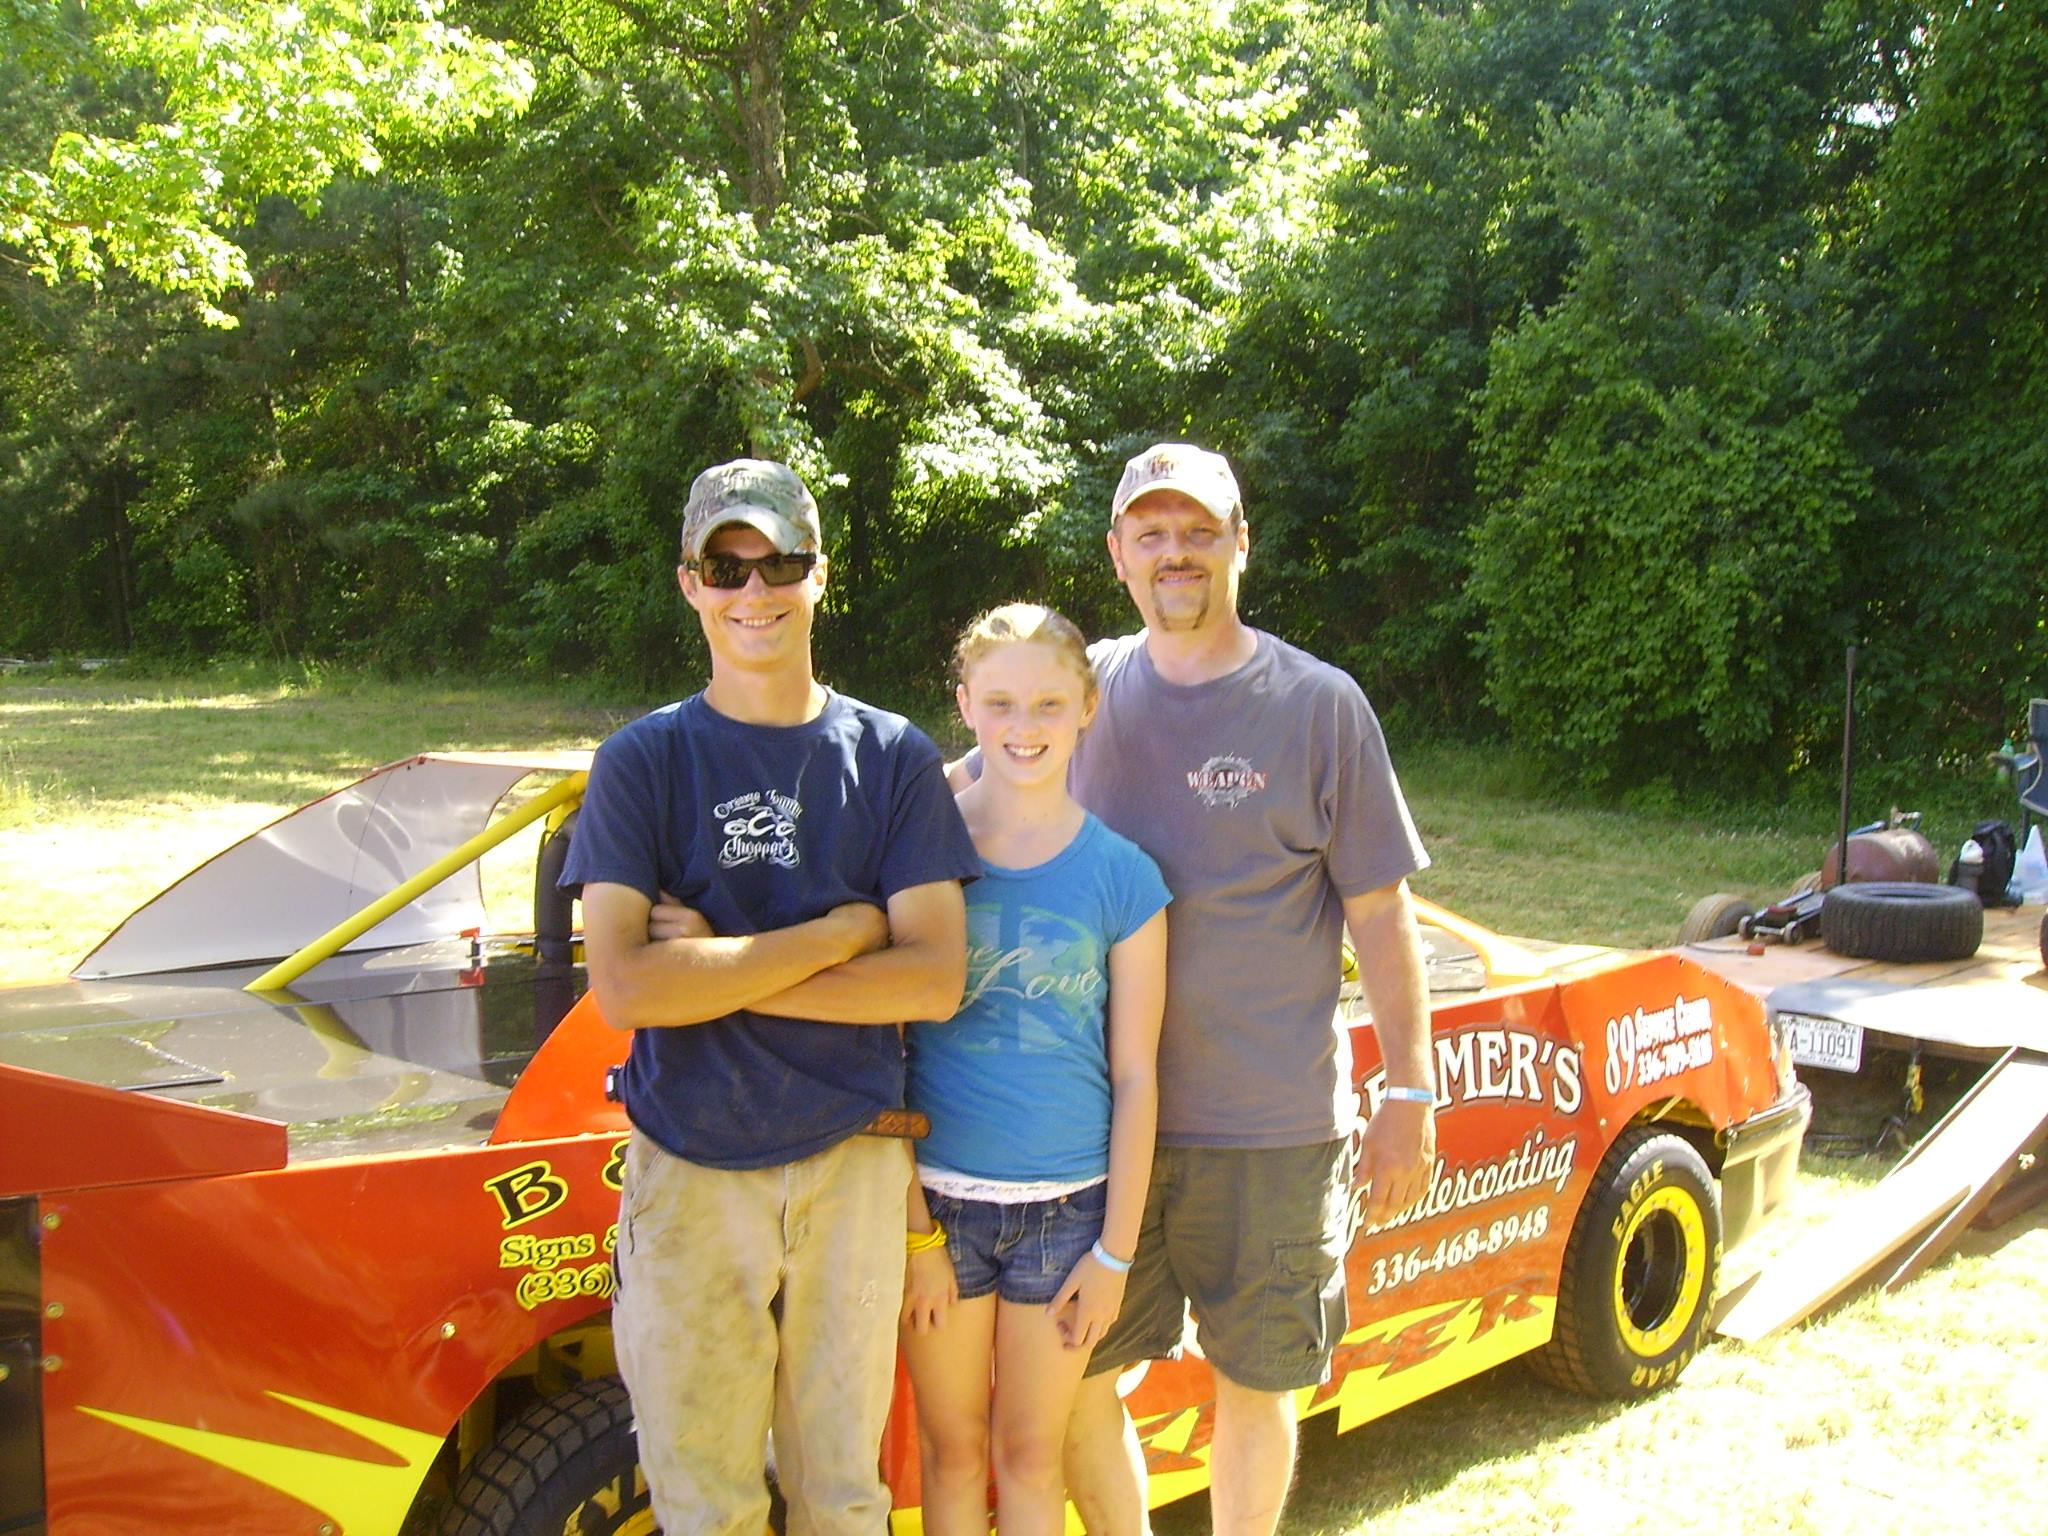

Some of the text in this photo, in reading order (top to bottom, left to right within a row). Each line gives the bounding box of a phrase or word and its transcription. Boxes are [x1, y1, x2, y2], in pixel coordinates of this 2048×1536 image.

[958, 947, 1102, 1013] Love
[1604, 1017, 1636, 1095] 89
[1789, 1028, 1855, 1060] A-11091
[483, 1159, 569, 1231] B
[1611, 1158, 1665, 1242] EAGLE
[499, 1233, 596, 1271] Signs
[1366, 1205, 1550, 1296] 336-468-8948
[516, 1261, 617, 1311] (336)
